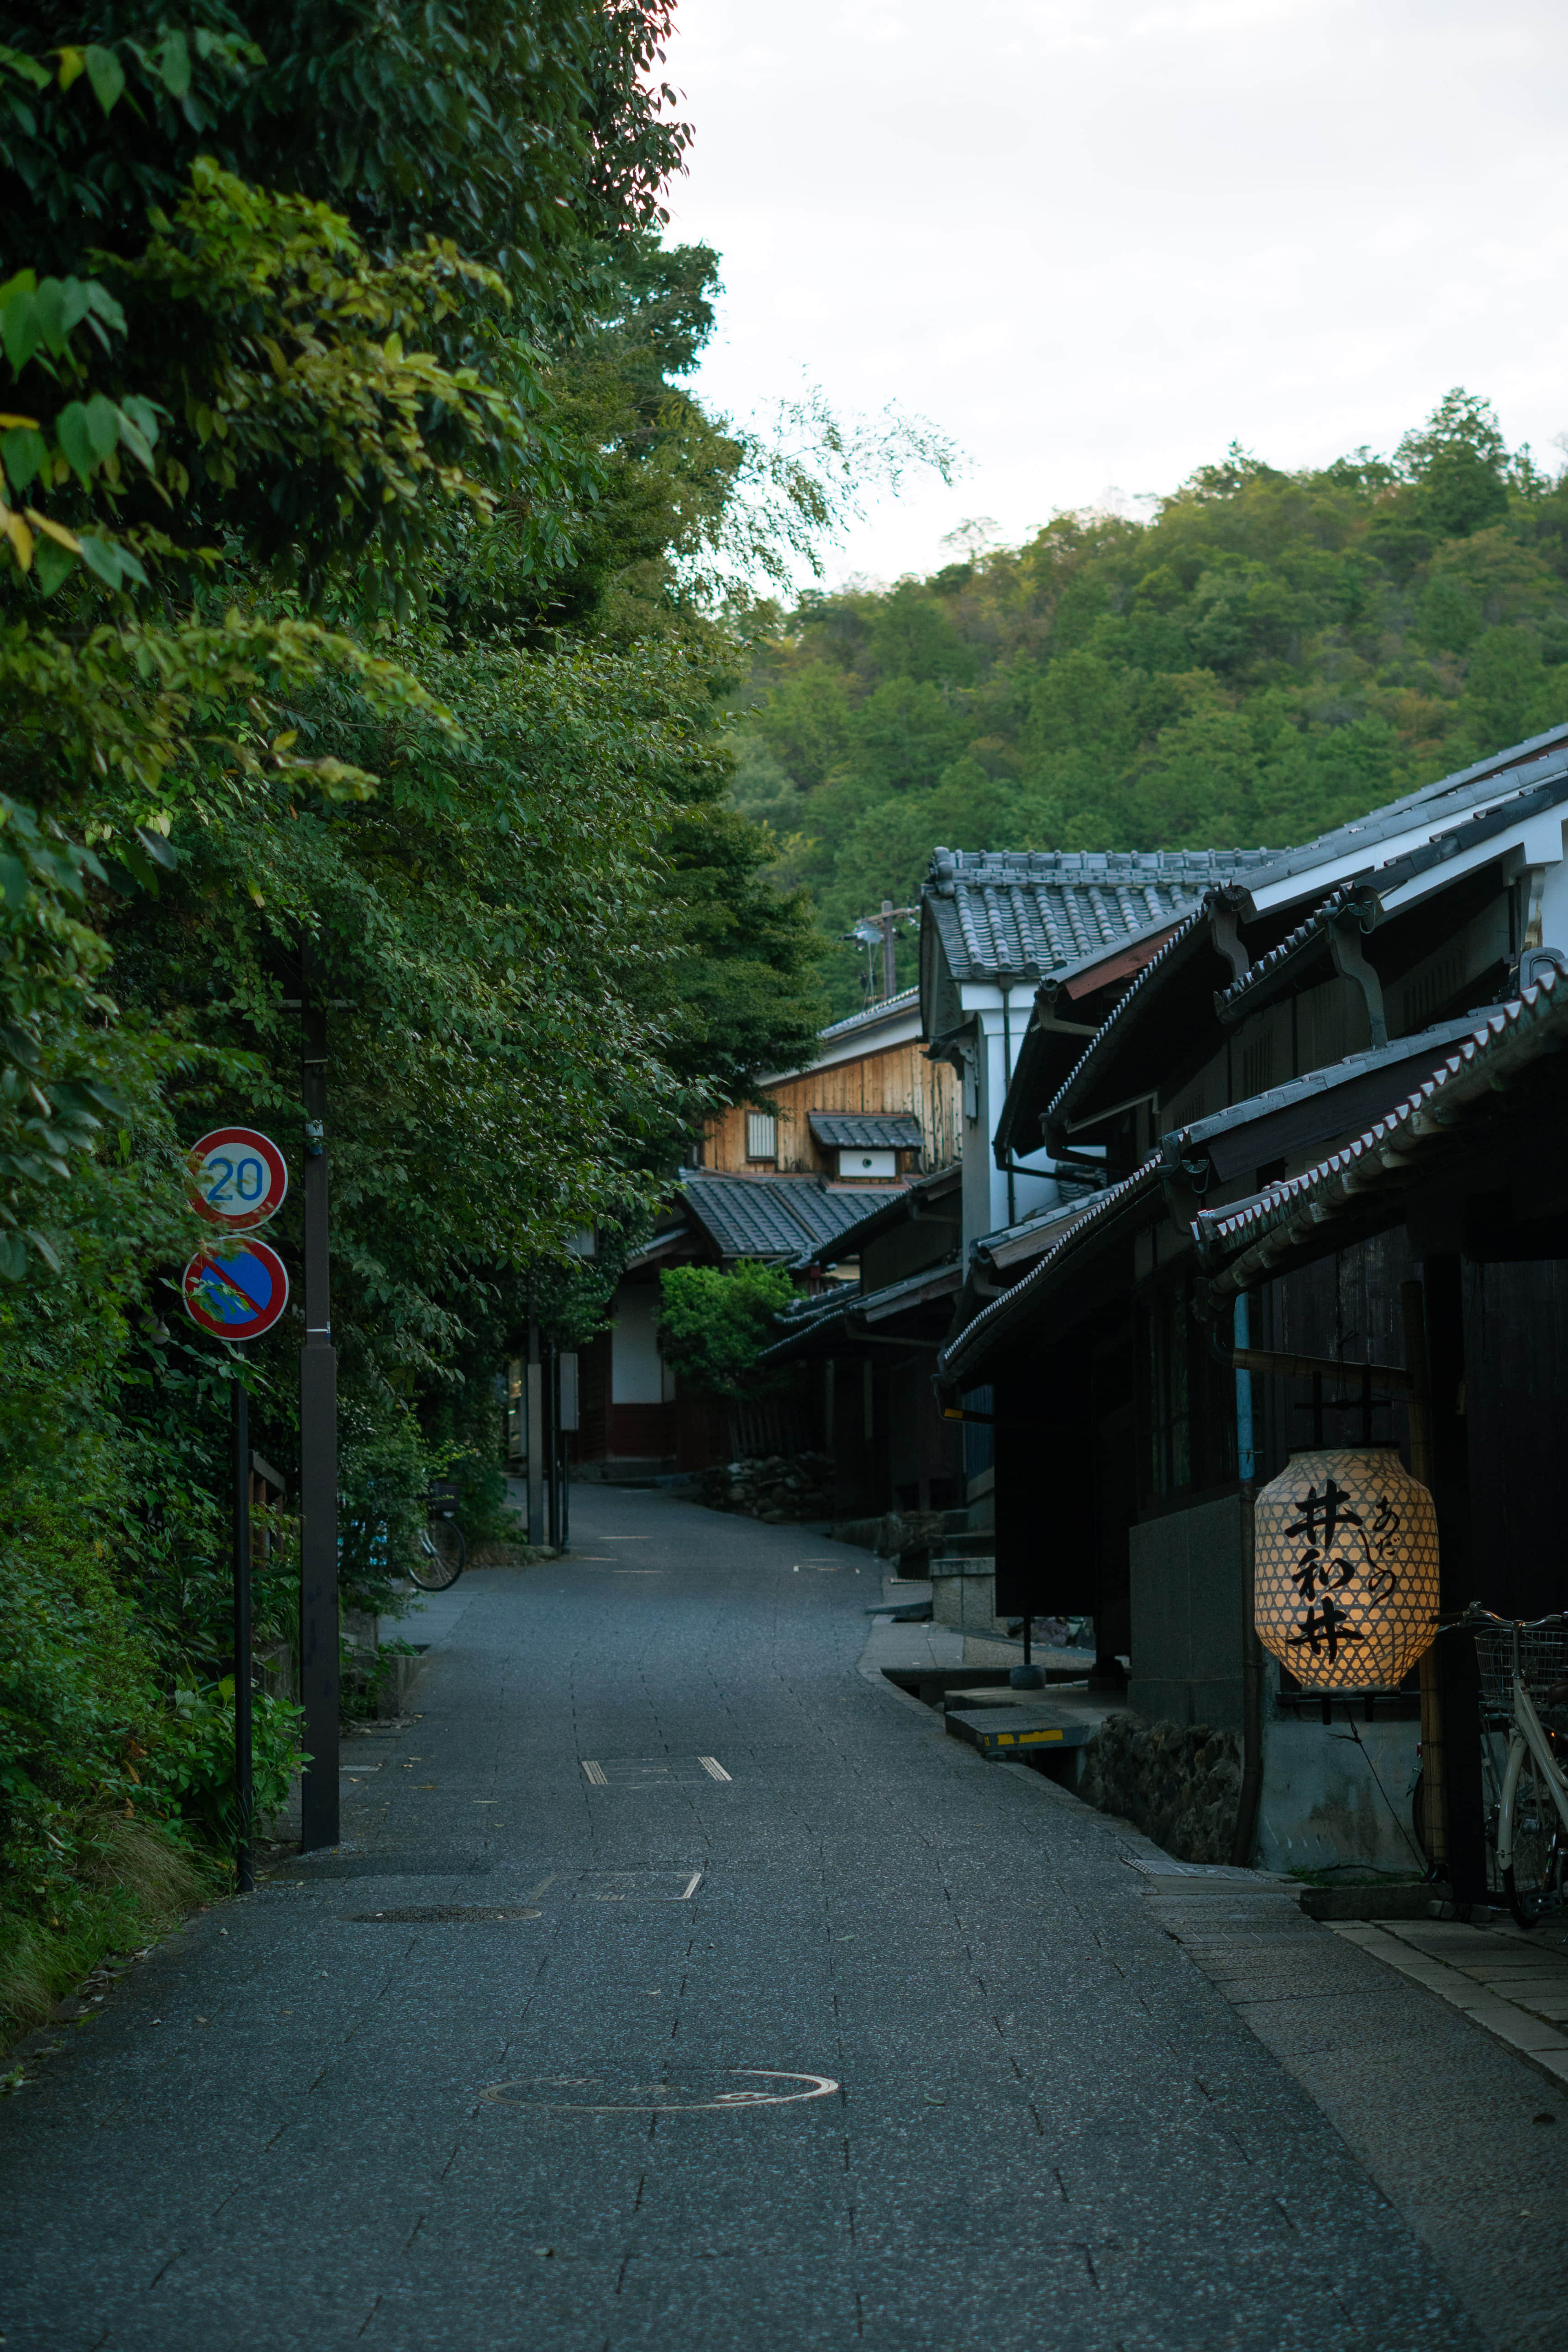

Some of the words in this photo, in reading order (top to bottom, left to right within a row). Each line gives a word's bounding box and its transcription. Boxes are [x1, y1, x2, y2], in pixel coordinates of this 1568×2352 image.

[208, 1158, 262, 1200] 20
[1284, 1479, 1364, 1665] 井和井
